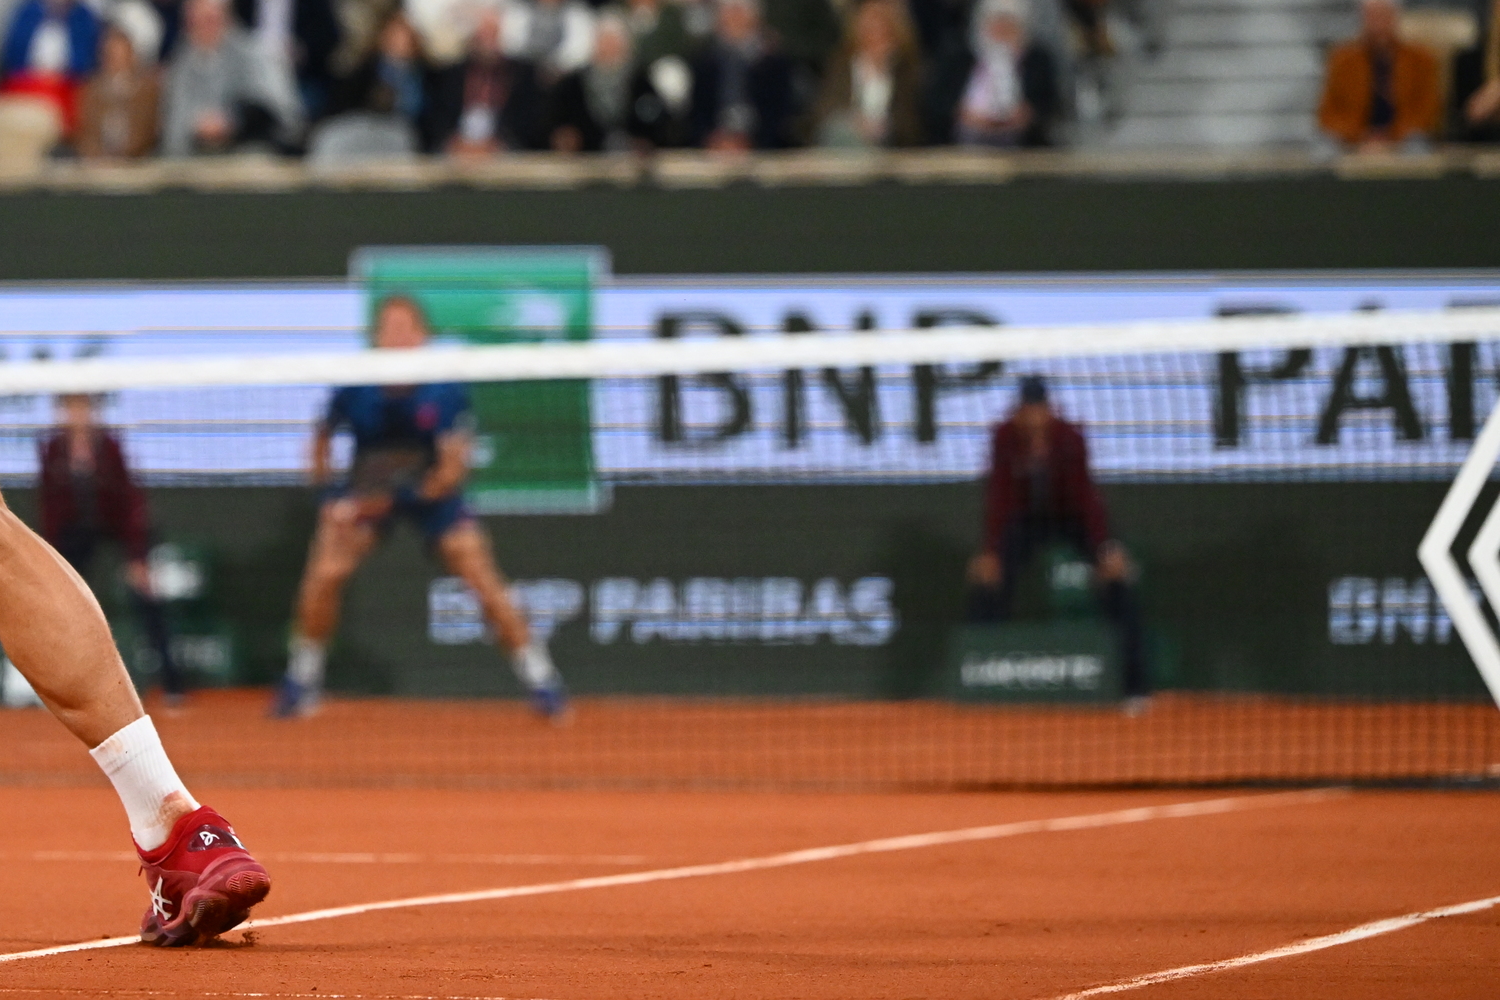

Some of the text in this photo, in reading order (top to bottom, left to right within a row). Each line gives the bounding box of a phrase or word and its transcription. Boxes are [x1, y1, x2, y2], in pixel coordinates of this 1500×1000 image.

[653, 303, 1006, 447] BNP
[428, 577, 896, 645] BP PARIBAS
